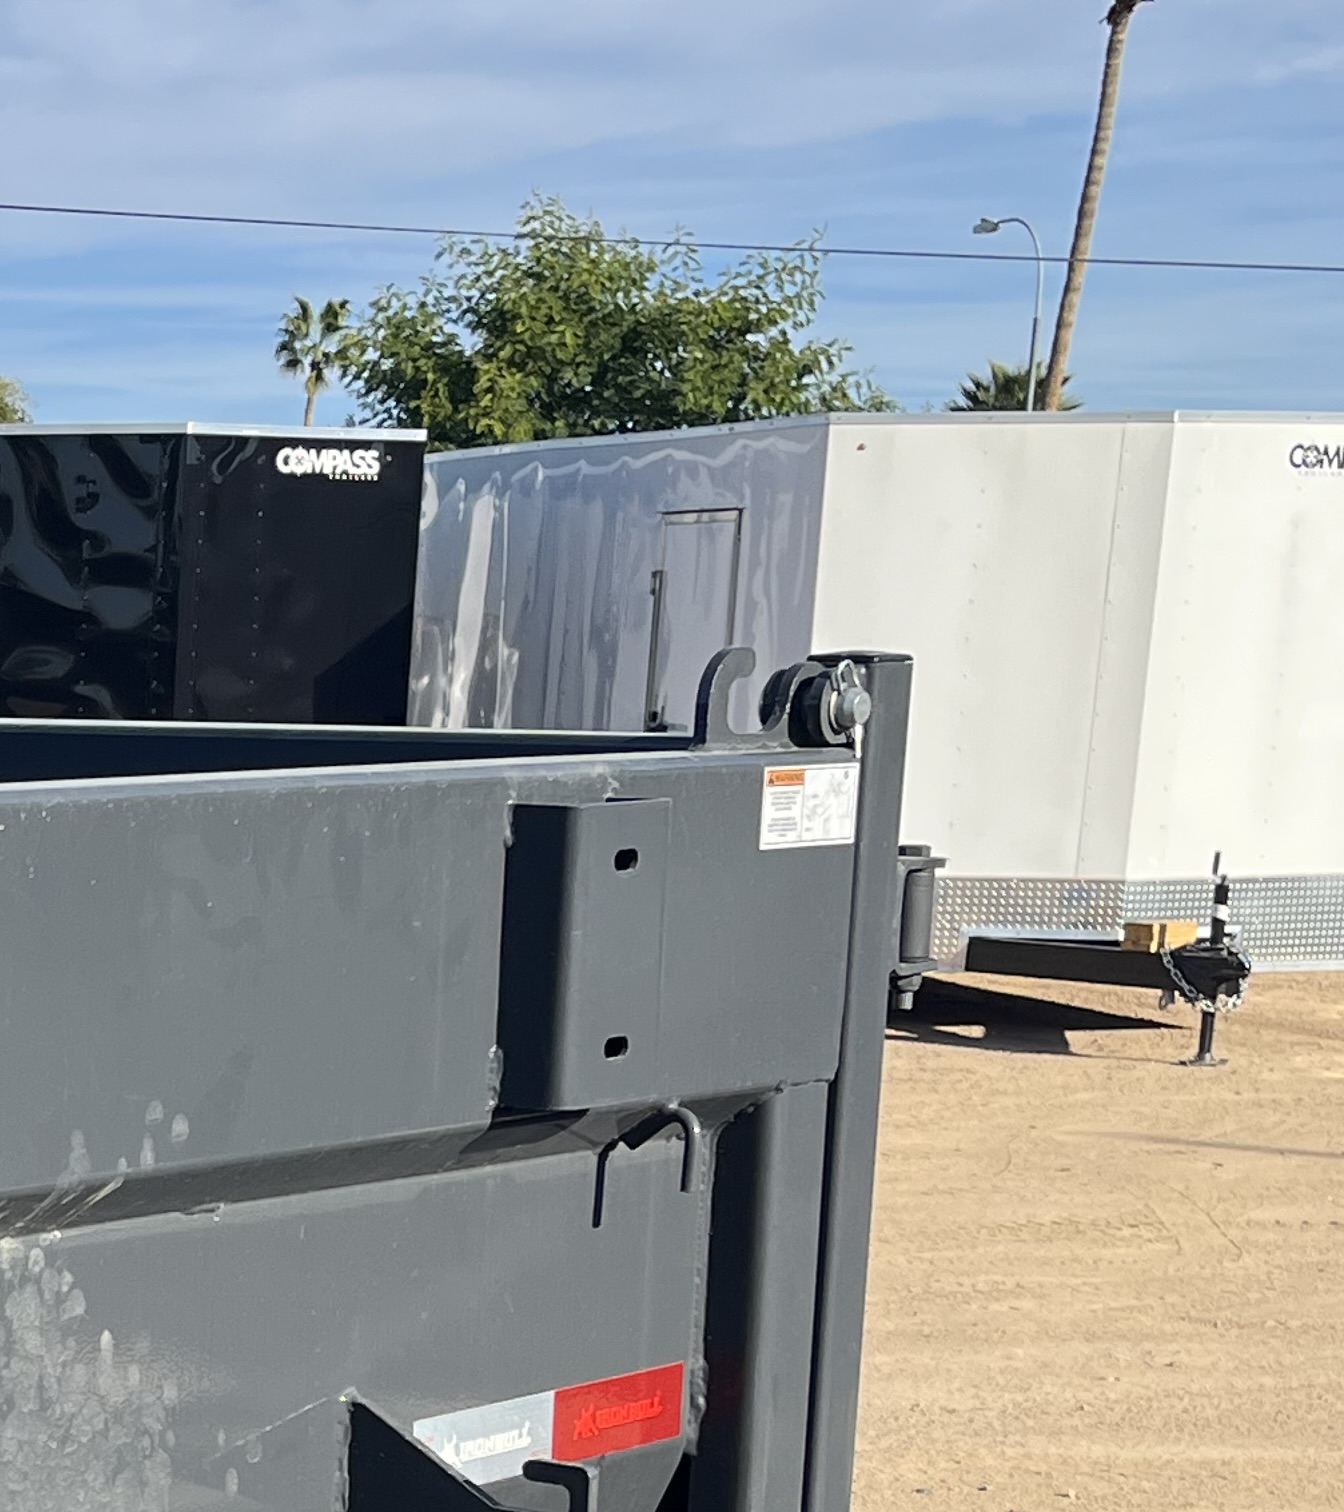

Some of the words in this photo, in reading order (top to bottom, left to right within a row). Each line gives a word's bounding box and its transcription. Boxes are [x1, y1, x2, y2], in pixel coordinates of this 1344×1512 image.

[275, 446, 381, 475] COMPASS
[1289, 443, 1344, 470] COM
[595, 1390, 663, 1429] IRONBULL
